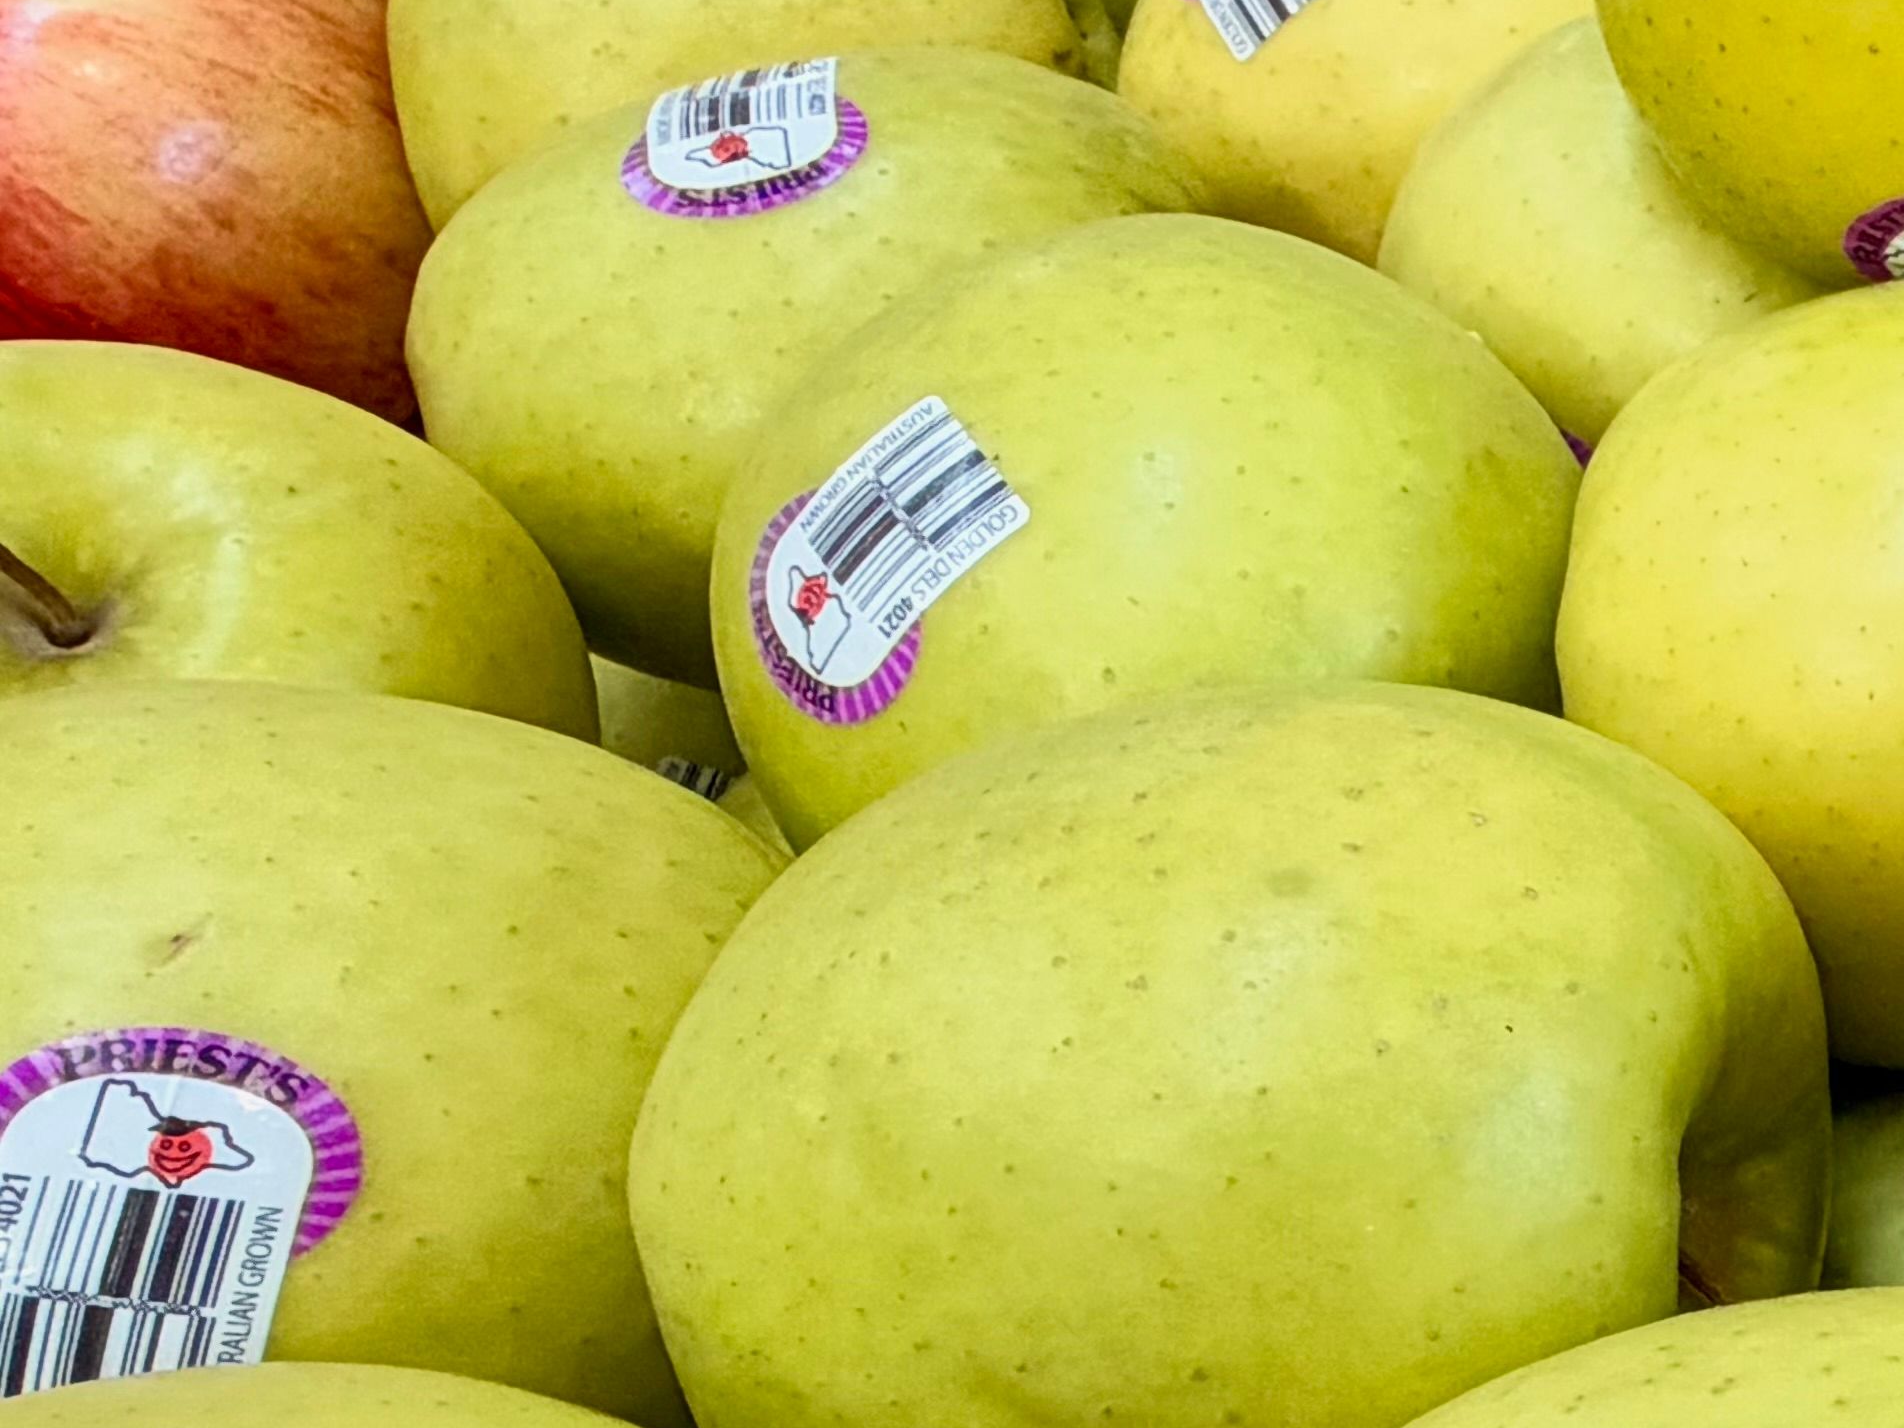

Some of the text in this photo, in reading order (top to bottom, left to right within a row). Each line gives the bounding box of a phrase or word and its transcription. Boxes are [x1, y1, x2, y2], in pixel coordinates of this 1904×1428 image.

[799, 402, 935, 534] AUSTRALIAN GROWN
[876, 504, 1019, 640] GOLDEN DELS 4021
[60, 1037, 310, 1105] PRIEST'S
[217, 1206, 284, 1365] RALIAN GROWN
